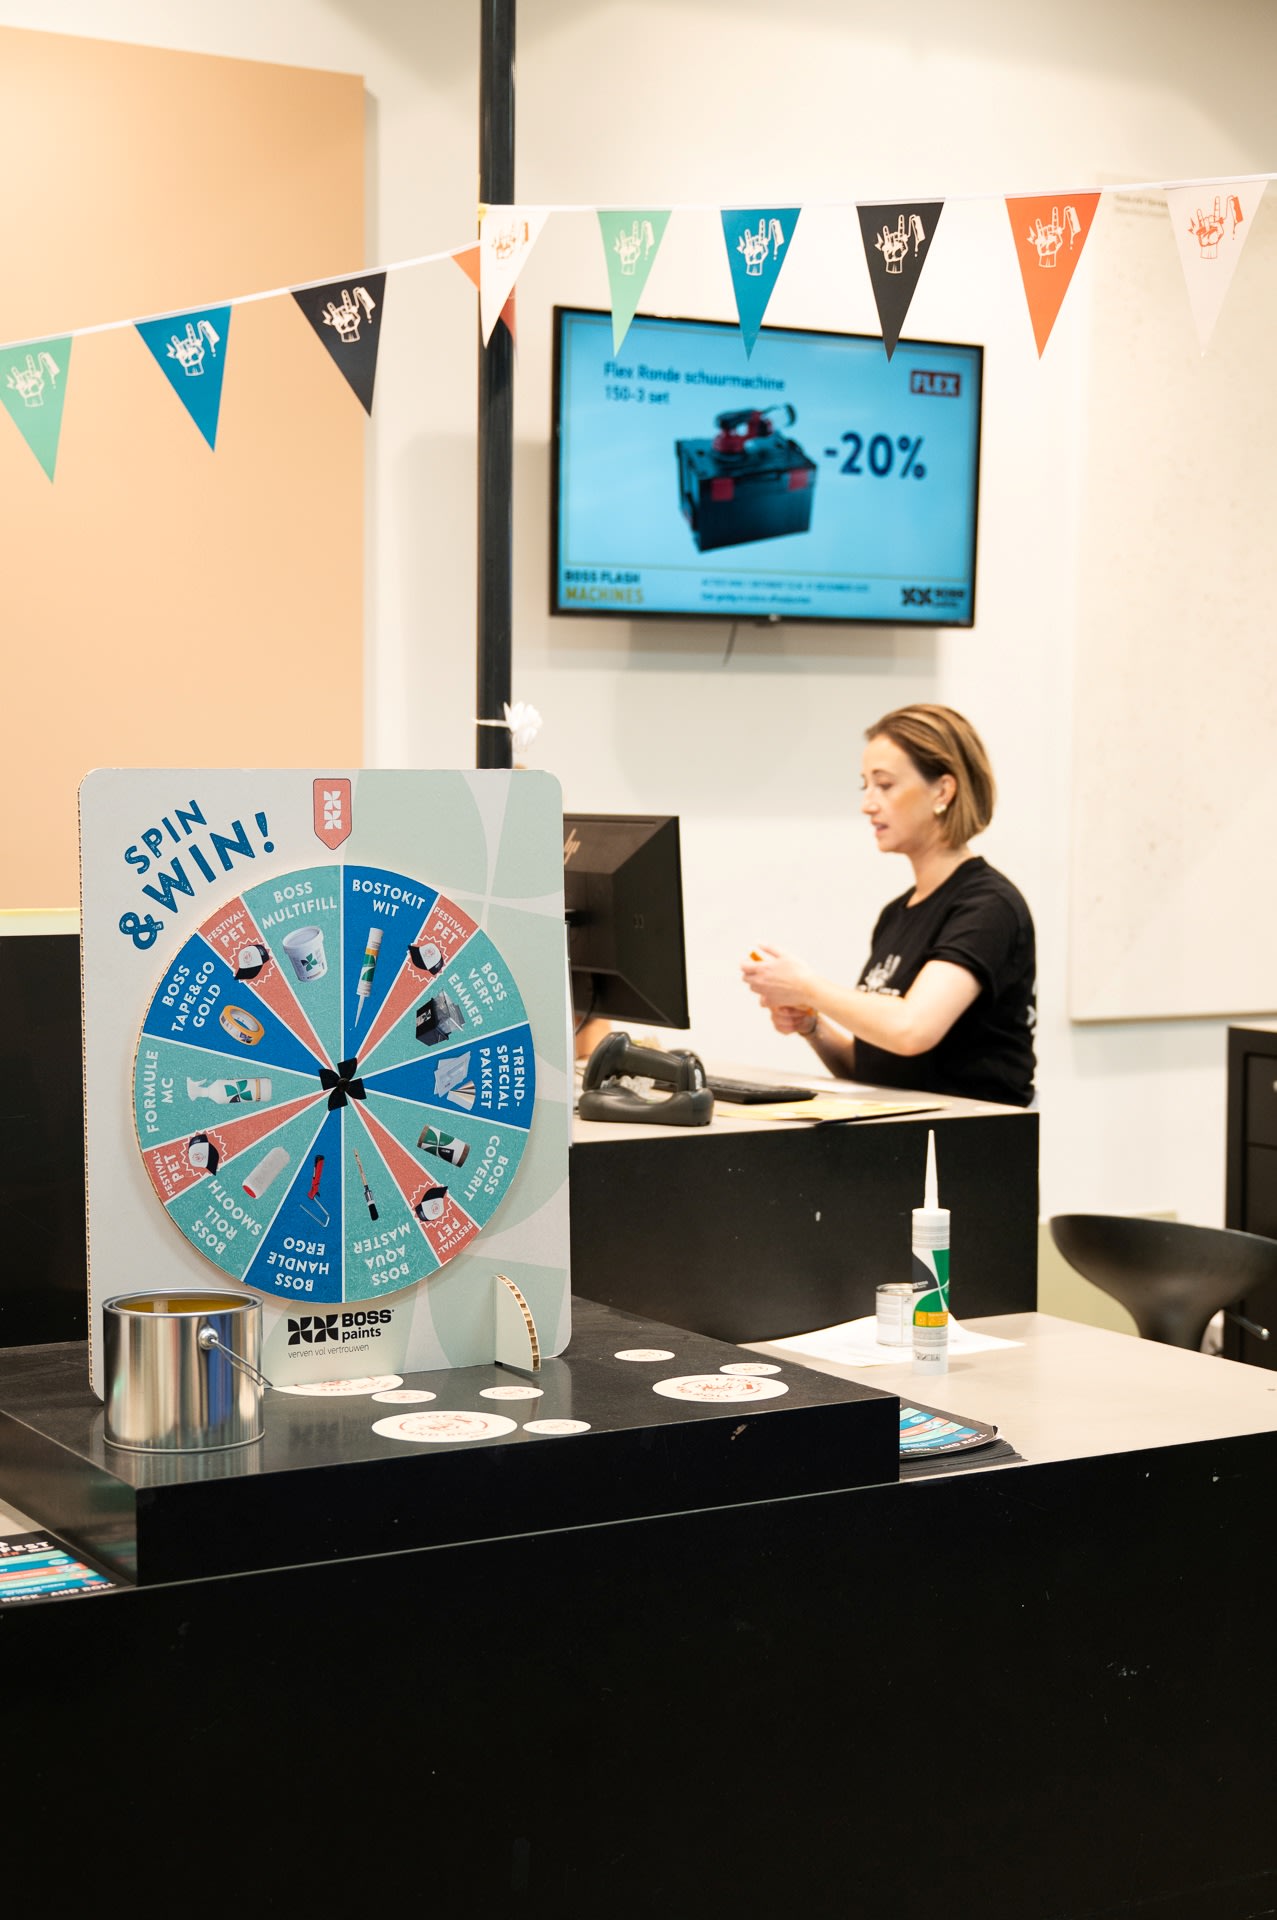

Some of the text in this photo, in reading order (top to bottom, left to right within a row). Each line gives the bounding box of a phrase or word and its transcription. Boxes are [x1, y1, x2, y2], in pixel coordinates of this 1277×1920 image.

[603, 361, 785, 391] Flex Ronde schuurmachine
[913, 373, 958, 395] FLEX
[649, 391, 670, 404] set
[824, 430, 926, 480] -20%
[565, 586, 644, 604] MACHINES
[124, 799, 207, 875] SPIN
[273, 881, 313, 903] BOSS
[352, 879, 426, 910] BOSTOKIT
[261, 896, 337, 929] MULTIFILL
[373, 899, 399, 917] WIT
[434, 907, 468, 938] FESTIVAL-
[207, 910, 246, 942] FESTIVAL-
[220, 921, 246, 947] PET
[433, 921, 458, 944] PET
[162, 965, 190, 1007] BOSS
[171, 961, 214, 1032] TAPE&GO
[468, 968, 493, 1011] VERF-
[481, 962, 507, 1001] BOSS
[193, 984, 221, 1028] GOLD
[448, 973, 483, 1027] EMMER
[143, 1050, 159, 1133] FORMULE
[161, 1077, 174, 1103] MC
[479, 1047, 492, 1109] PAKKET
[497, 1045, 509, 1110] SPECIAL
[513, 1046, 524, 1107] TREND-
[153, 1150, 175, 1197] FESTIVAL-
[164, 1155, 184, 1182] PET
[464, 1135, 500, 1201] COVERIT
[484, 1155, 509, 1195] BOSS
[205, 1205, 237, 1240] ROLL
[208, 1180, 262, 1236] SMOOTH
[191, 1220, 226, 1255] BOSS
[353, 1222, 411, 1254] MASTER
[437, 1217, 460, 1243] PET
[438, 1221, 473, 1254] FESTIVAL-
[283, 1237, 325, 1256] ERGO
[364, 1244, 405, 1270] AQUA
[267, 1251, 329, 1275] HANDLE
[372, 1262, 409, 1286] BOSS
[274, 1272, 314, 1292] BOSS
[342, 1309, 392, 1327] BOSS
[342, 1327, 381, 1343] paints
[288, 1343, 369, 1359] verven vol vertrouwen
[961, 1433, 988, 1445] ROLL
[50, 1588, 79, 1597] AND
[81, 1582, 117, 1592] ROLL
